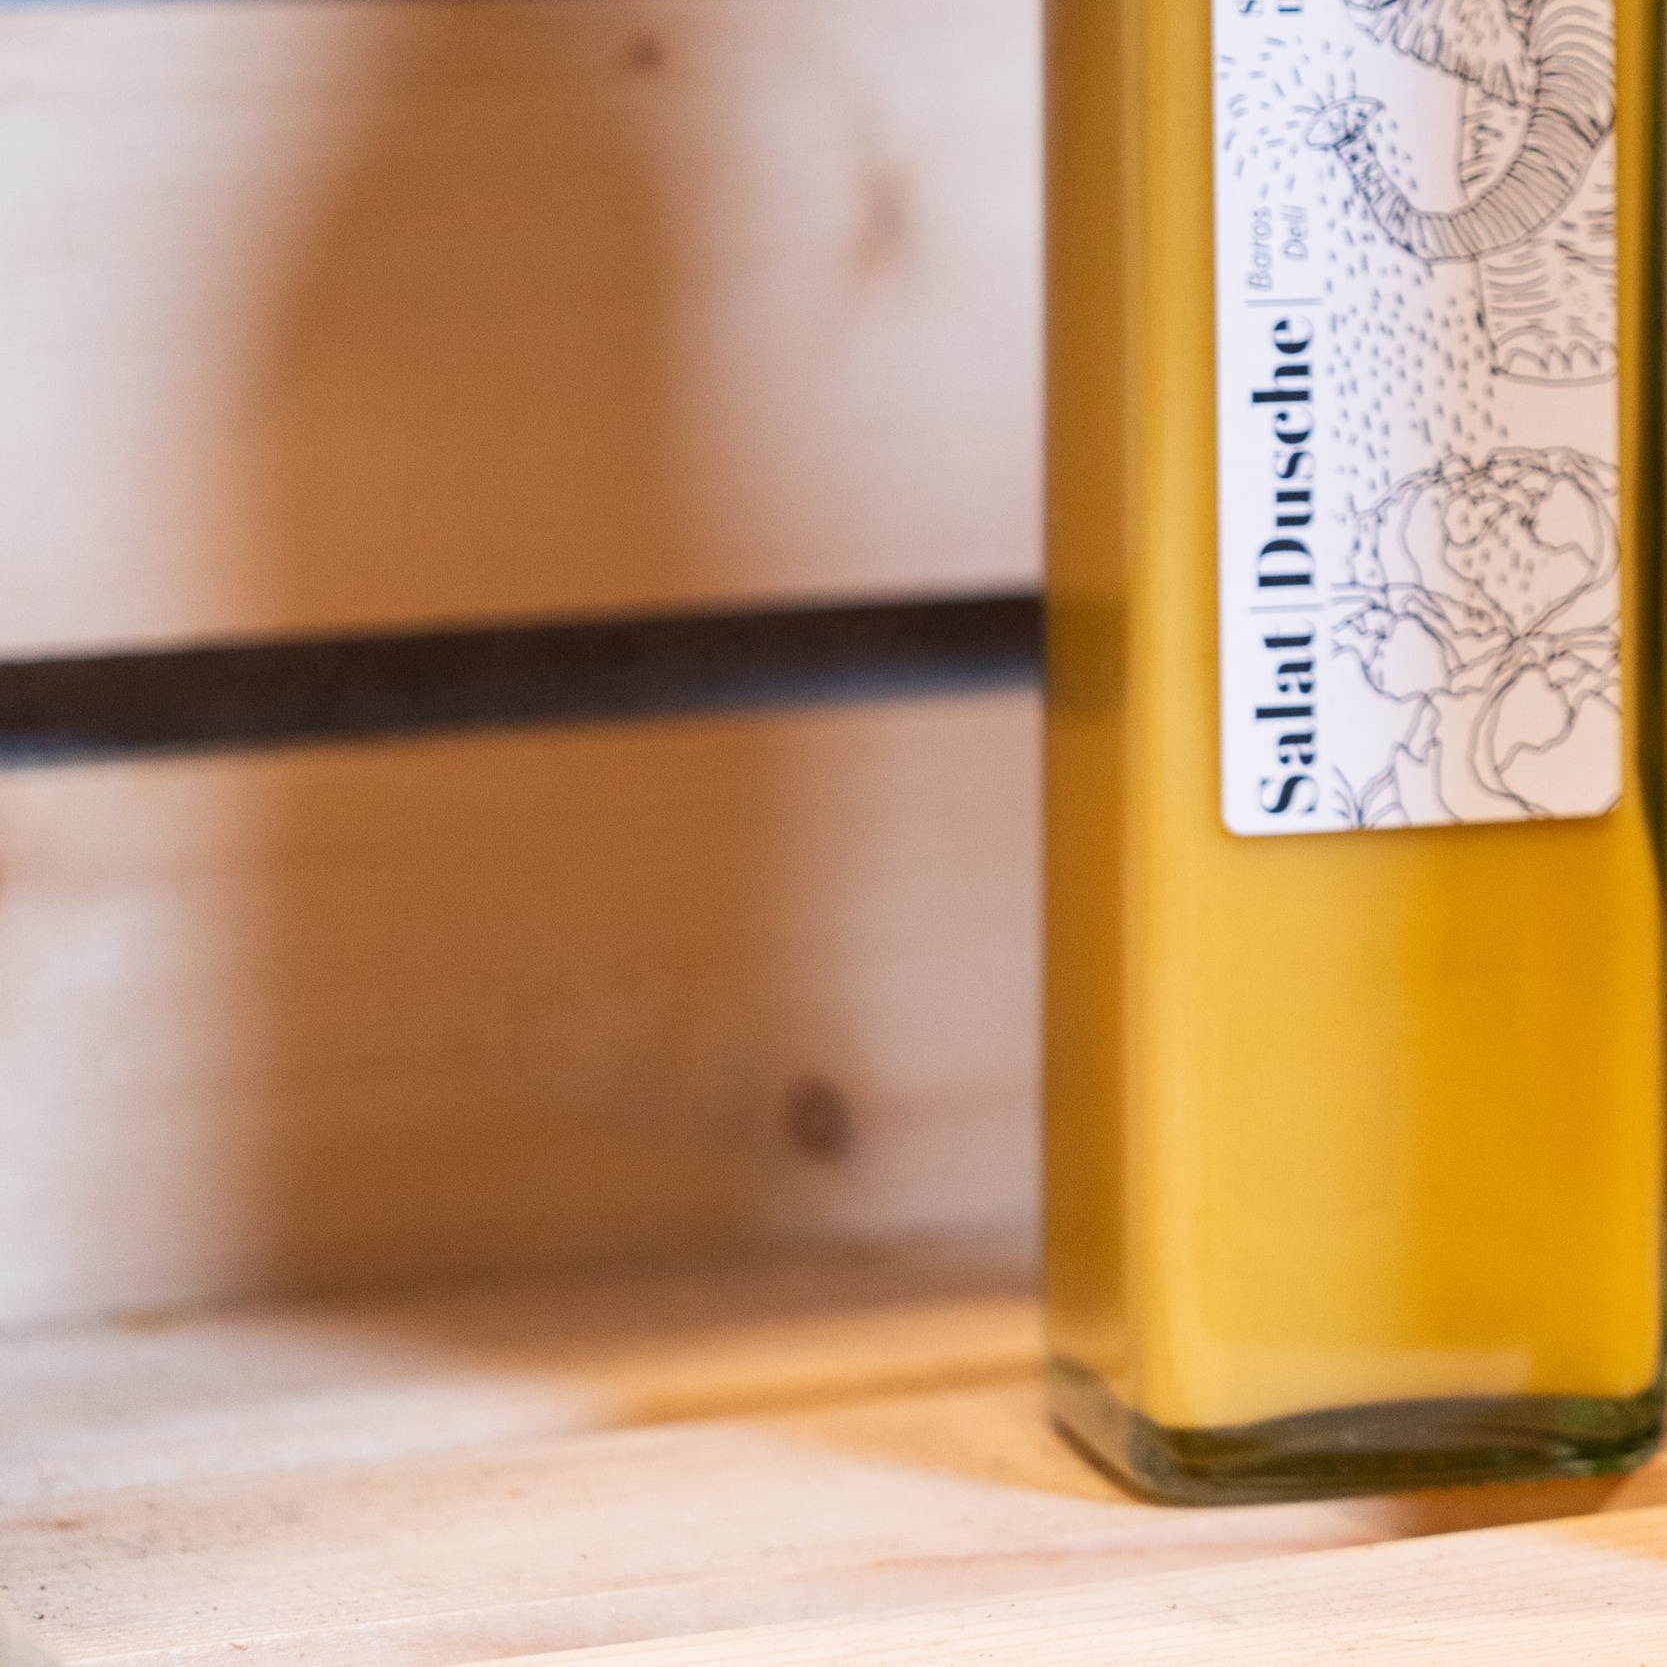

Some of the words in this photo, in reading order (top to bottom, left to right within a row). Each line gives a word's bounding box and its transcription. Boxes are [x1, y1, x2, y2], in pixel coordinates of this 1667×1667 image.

[1246, 207, 1273, 292] Baros
[1280, 205, 1309, 261] Deli
[1251, 320, 1313, 587] Dusche
[1255, 633, 1315, 814] Salat
